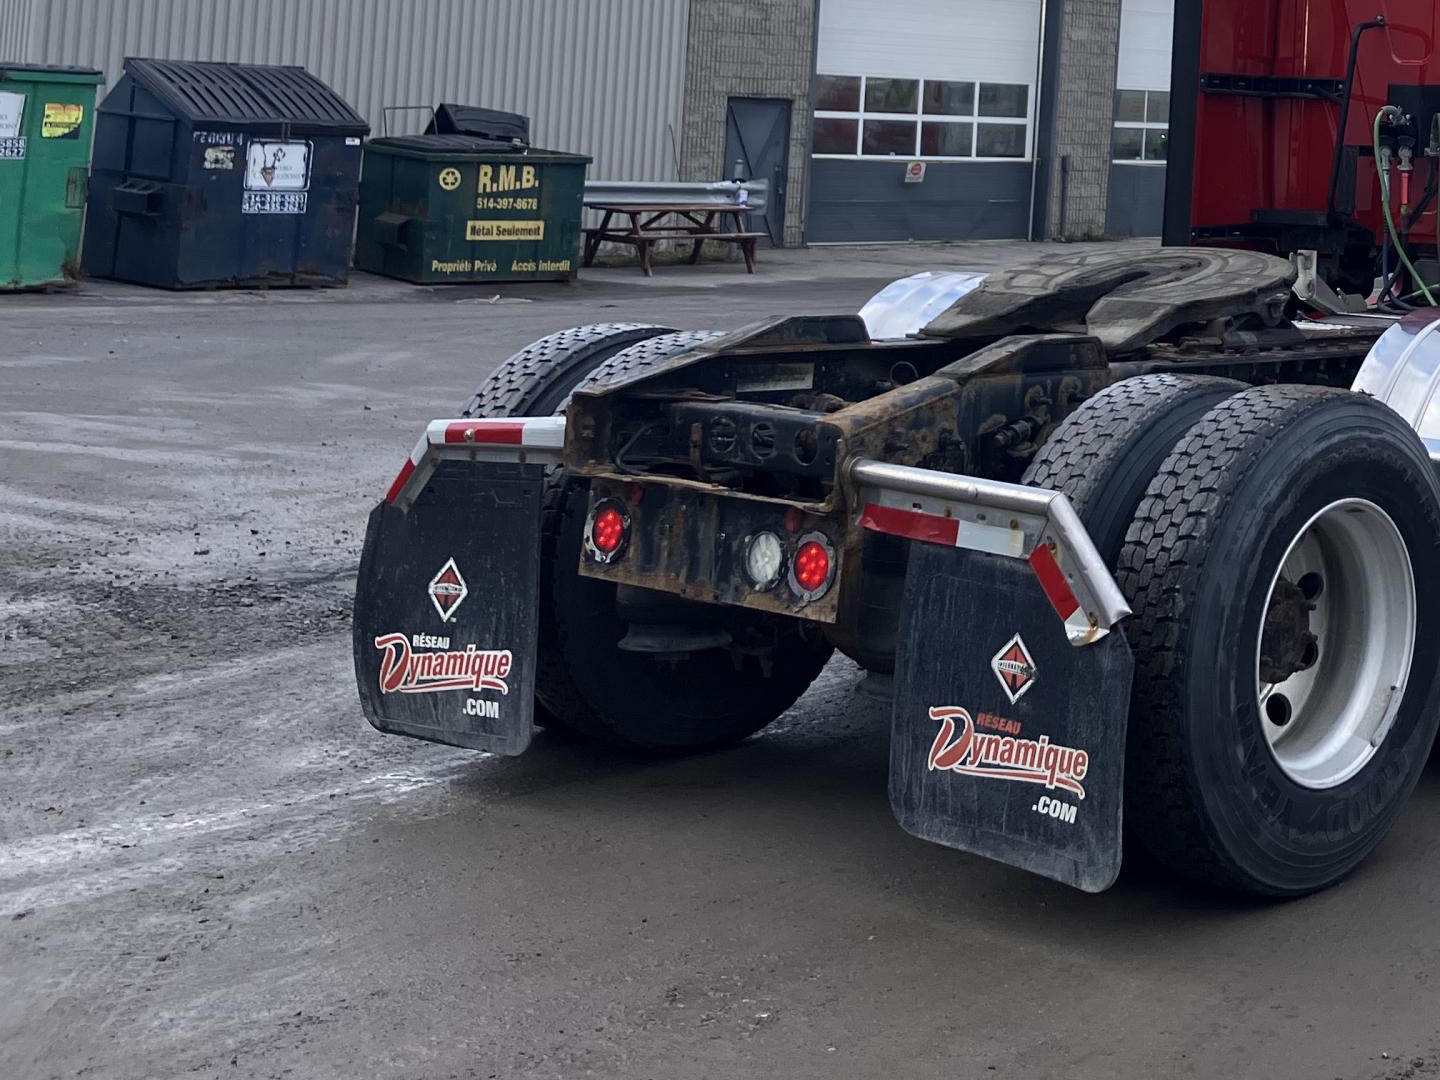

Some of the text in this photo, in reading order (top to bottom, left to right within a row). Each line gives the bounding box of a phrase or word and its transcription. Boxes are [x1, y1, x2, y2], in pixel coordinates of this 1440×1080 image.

[478, 164, 539, 194] R.M.B.
[476, 197, 538, 210] 514-397-8678
[495, 224, 541, 237] Seulement
[412, 632, 450, 650] RÉSEAU
[375, 633, 512, 694] Dynamique
[462, 698, 499, 719] .COM
[976, 712, 1022, 735] RÉSEAU
[929, 706, 1089, 792] Dynamique
[1032, 795, 1078, 824] .COM
